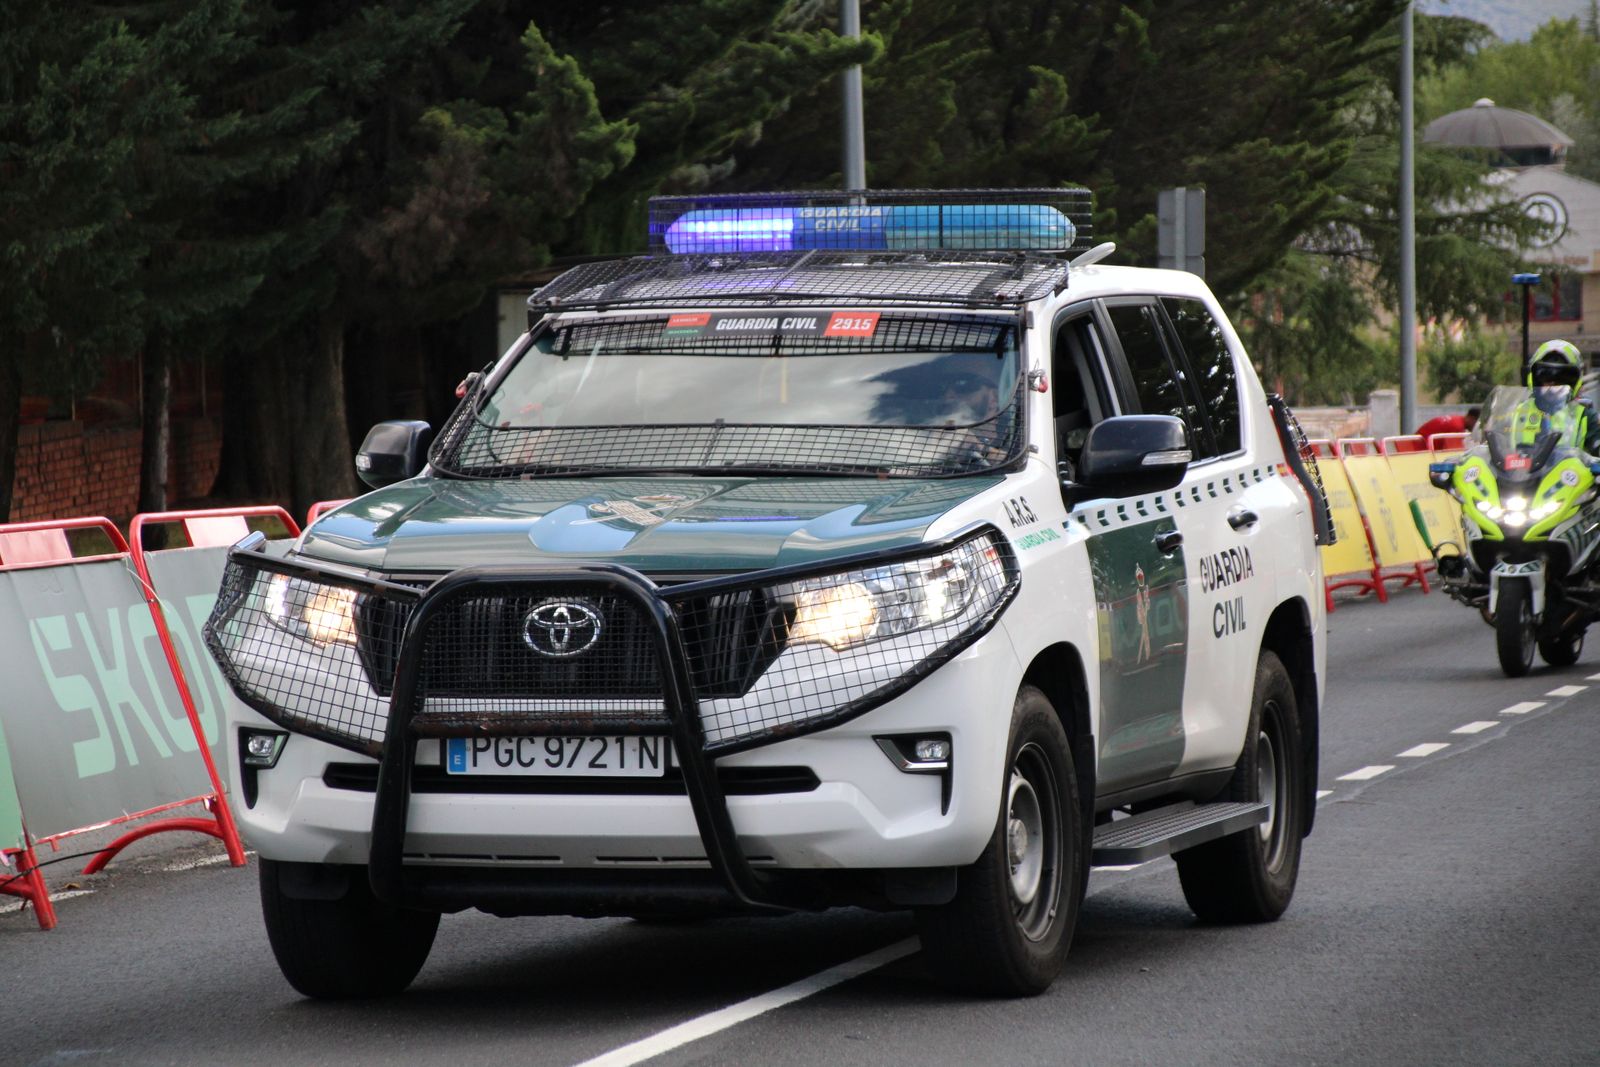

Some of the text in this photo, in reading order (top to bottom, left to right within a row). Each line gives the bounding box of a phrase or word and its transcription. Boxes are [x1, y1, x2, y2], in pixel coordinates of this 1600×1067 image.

[800, 207, 882, 218] GUARDIA
[815, 219, 862, 232] CIVIL
[715, 317, 778, 331] GUARDIA
[781, 317, 818, 330] CIVIL
[831, 317, 873, 330] 2915
[1002, 495, 1039, 529] A.R.S.
[1200, 545, 1254, 594] GUARDIA
[1212, 596, 1246, 639] CIVIL
[472, 736, 536, 768] PGC
[543, 736, 626, 769] 9721
